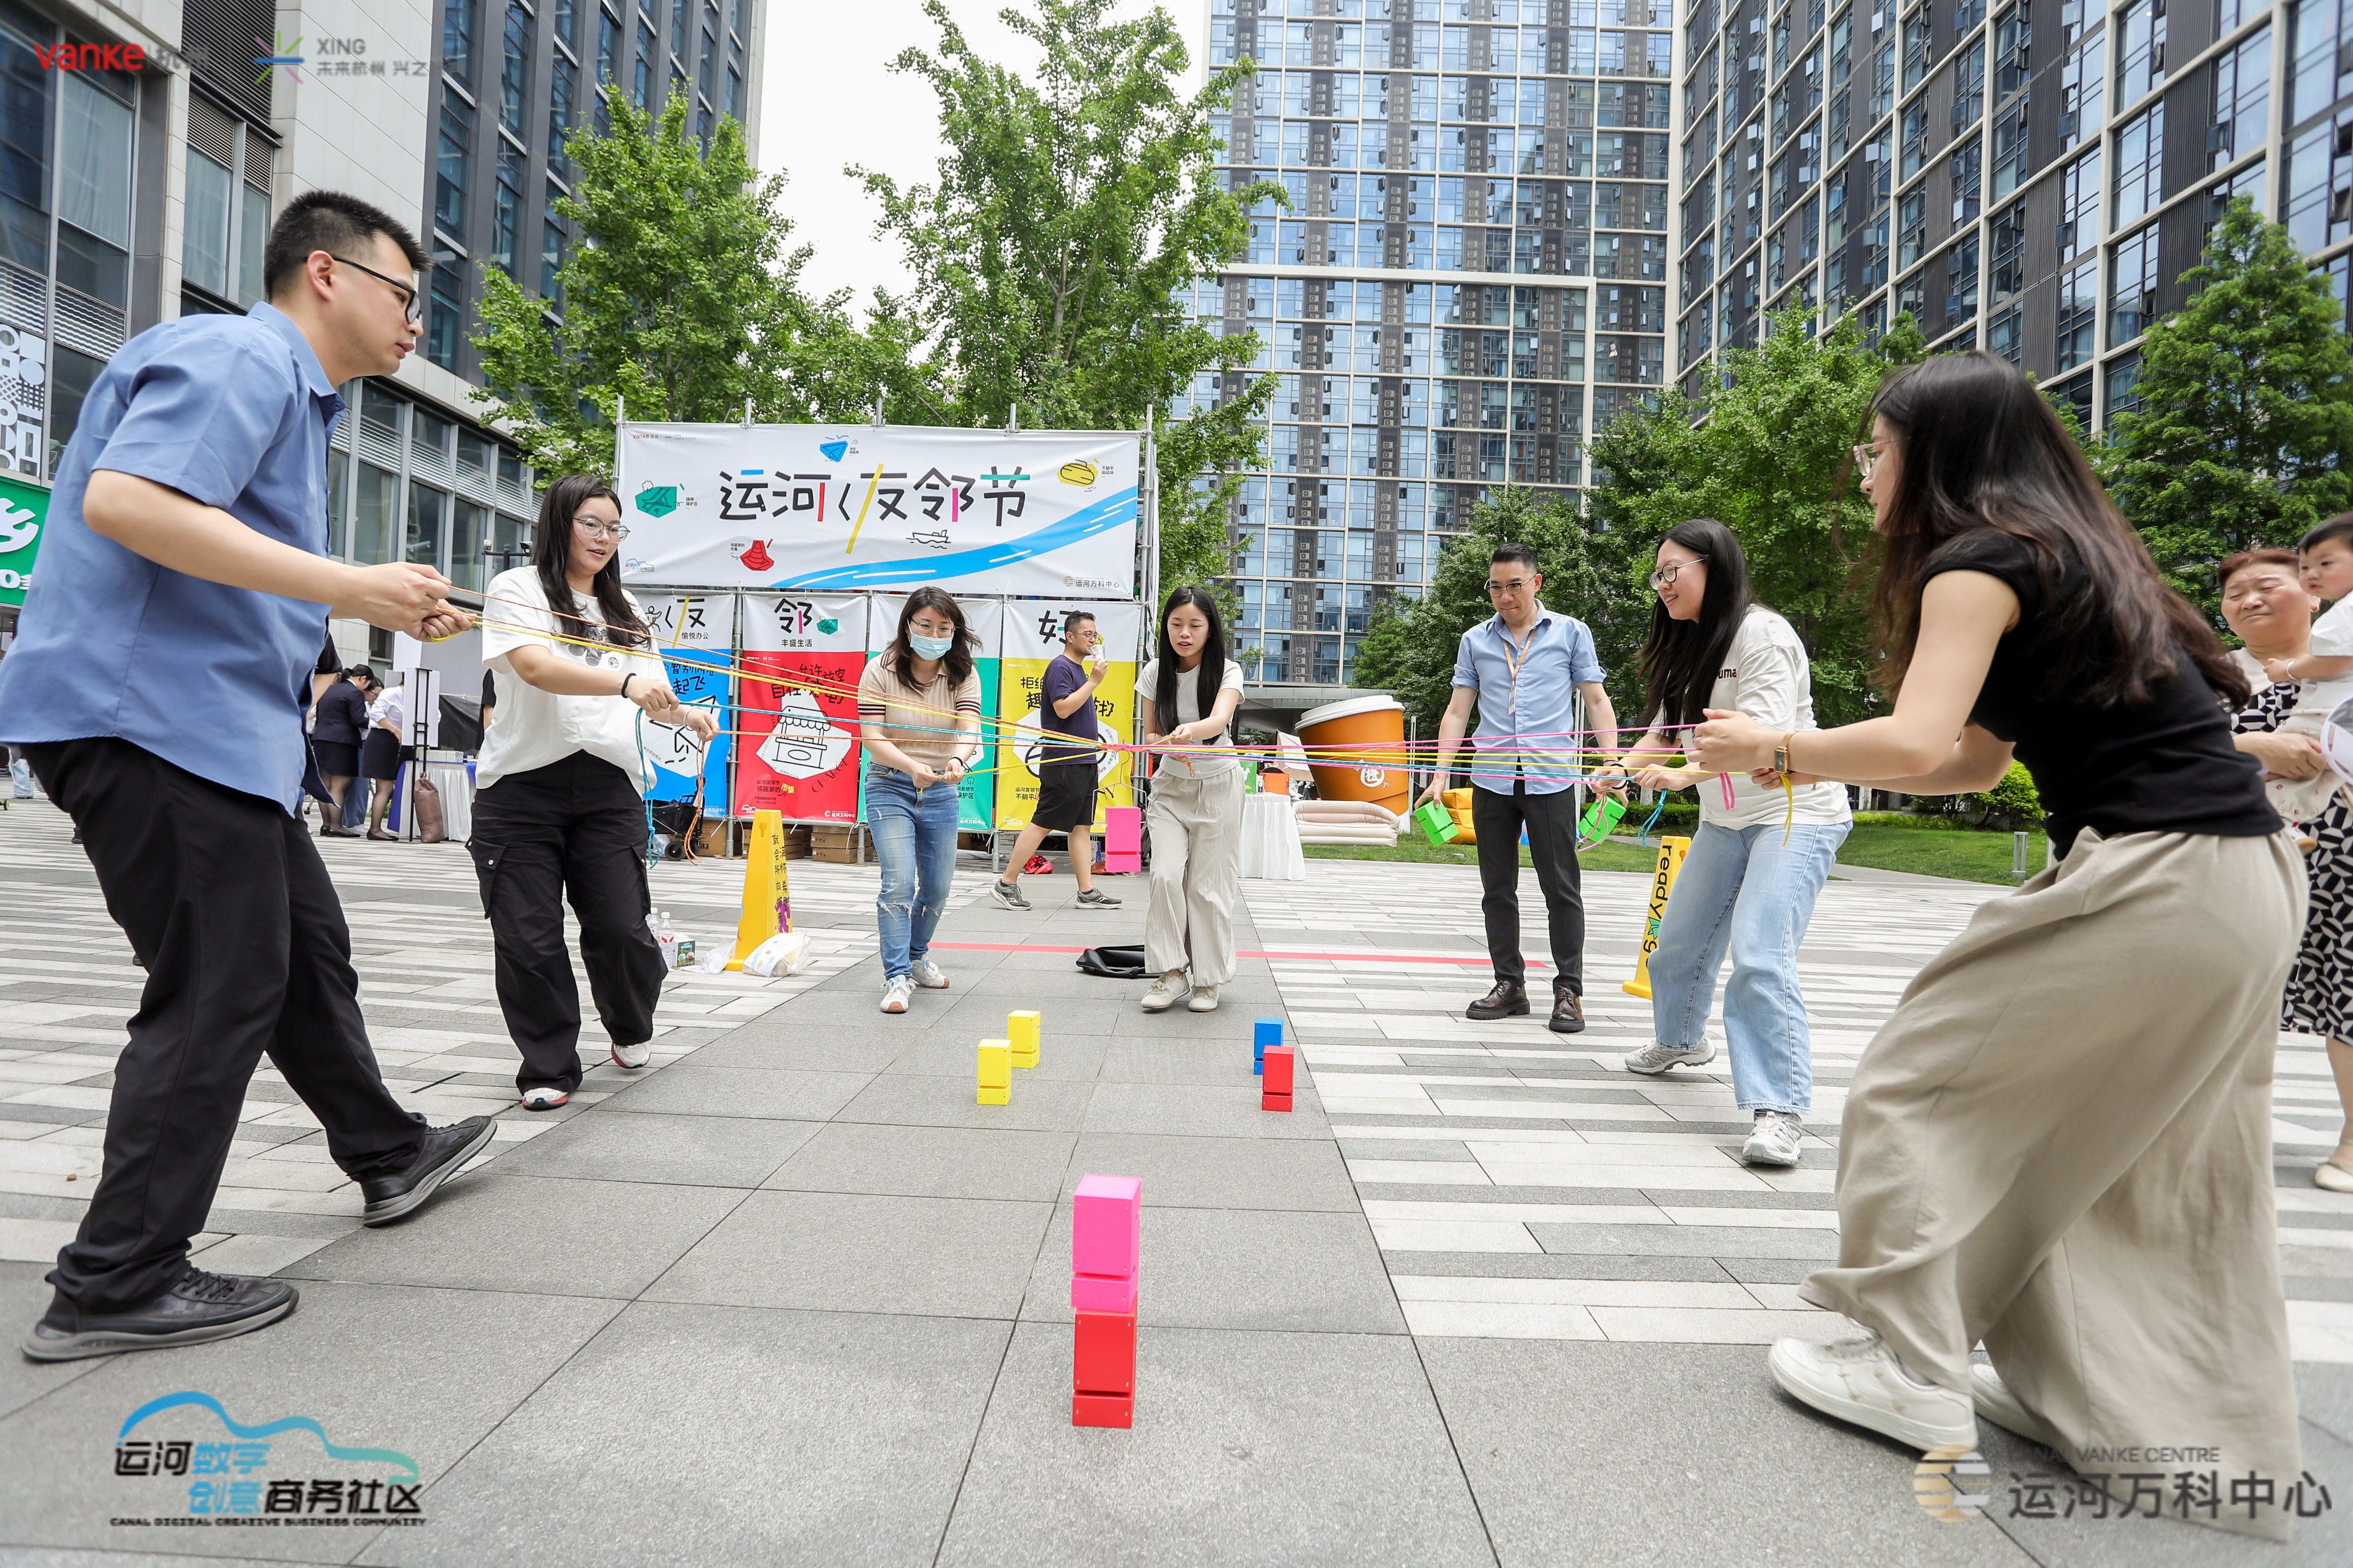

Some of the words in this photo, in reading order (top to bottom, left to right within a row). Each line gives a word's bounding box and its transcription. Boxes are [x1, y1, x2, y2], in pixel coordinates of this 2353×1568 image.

[1075, 579, 1120, 588] 运河万科中心
[774, 598, 812, 634] 邻
[681, 632, 709, 640] 愉悦办公
[781, 639, 813, 648] 丰盛生活
[672, 675, 706, 695] 起飞
[781, 783, 795, 794] 市集
[1649, 845, 1672, 920] ready
